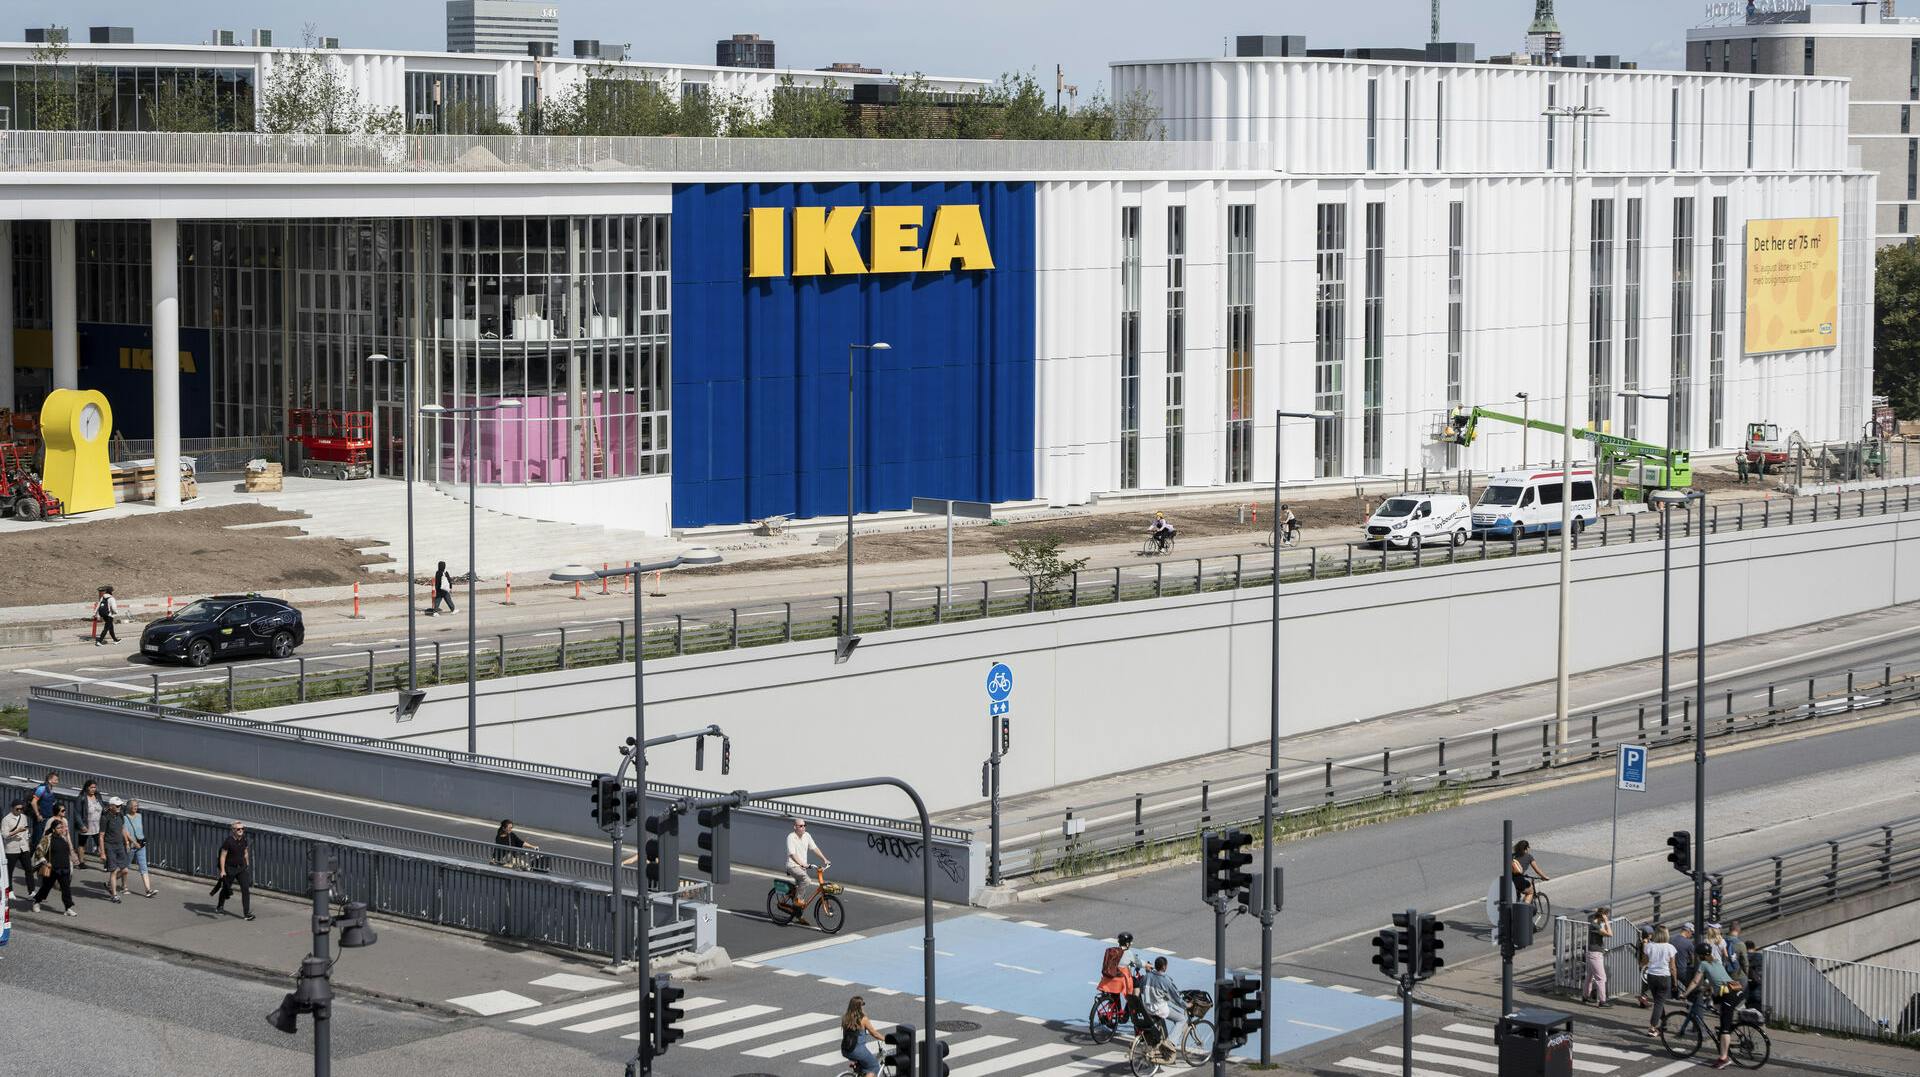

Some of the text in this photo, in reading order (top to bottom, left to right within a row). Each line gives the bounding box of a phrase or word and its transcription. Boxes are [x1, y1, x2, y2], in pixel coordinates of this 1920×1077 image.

[541, 8, 558, 17] SAS
[1705, 2, 1743, 17] HOTEL
[749, 204, 996, 278] IKEA
[1754, 234, 1821, 251] Det her er 75 m²
[119, 346, 198, 373] IKA
[1628, 751, 1639, 767] P
